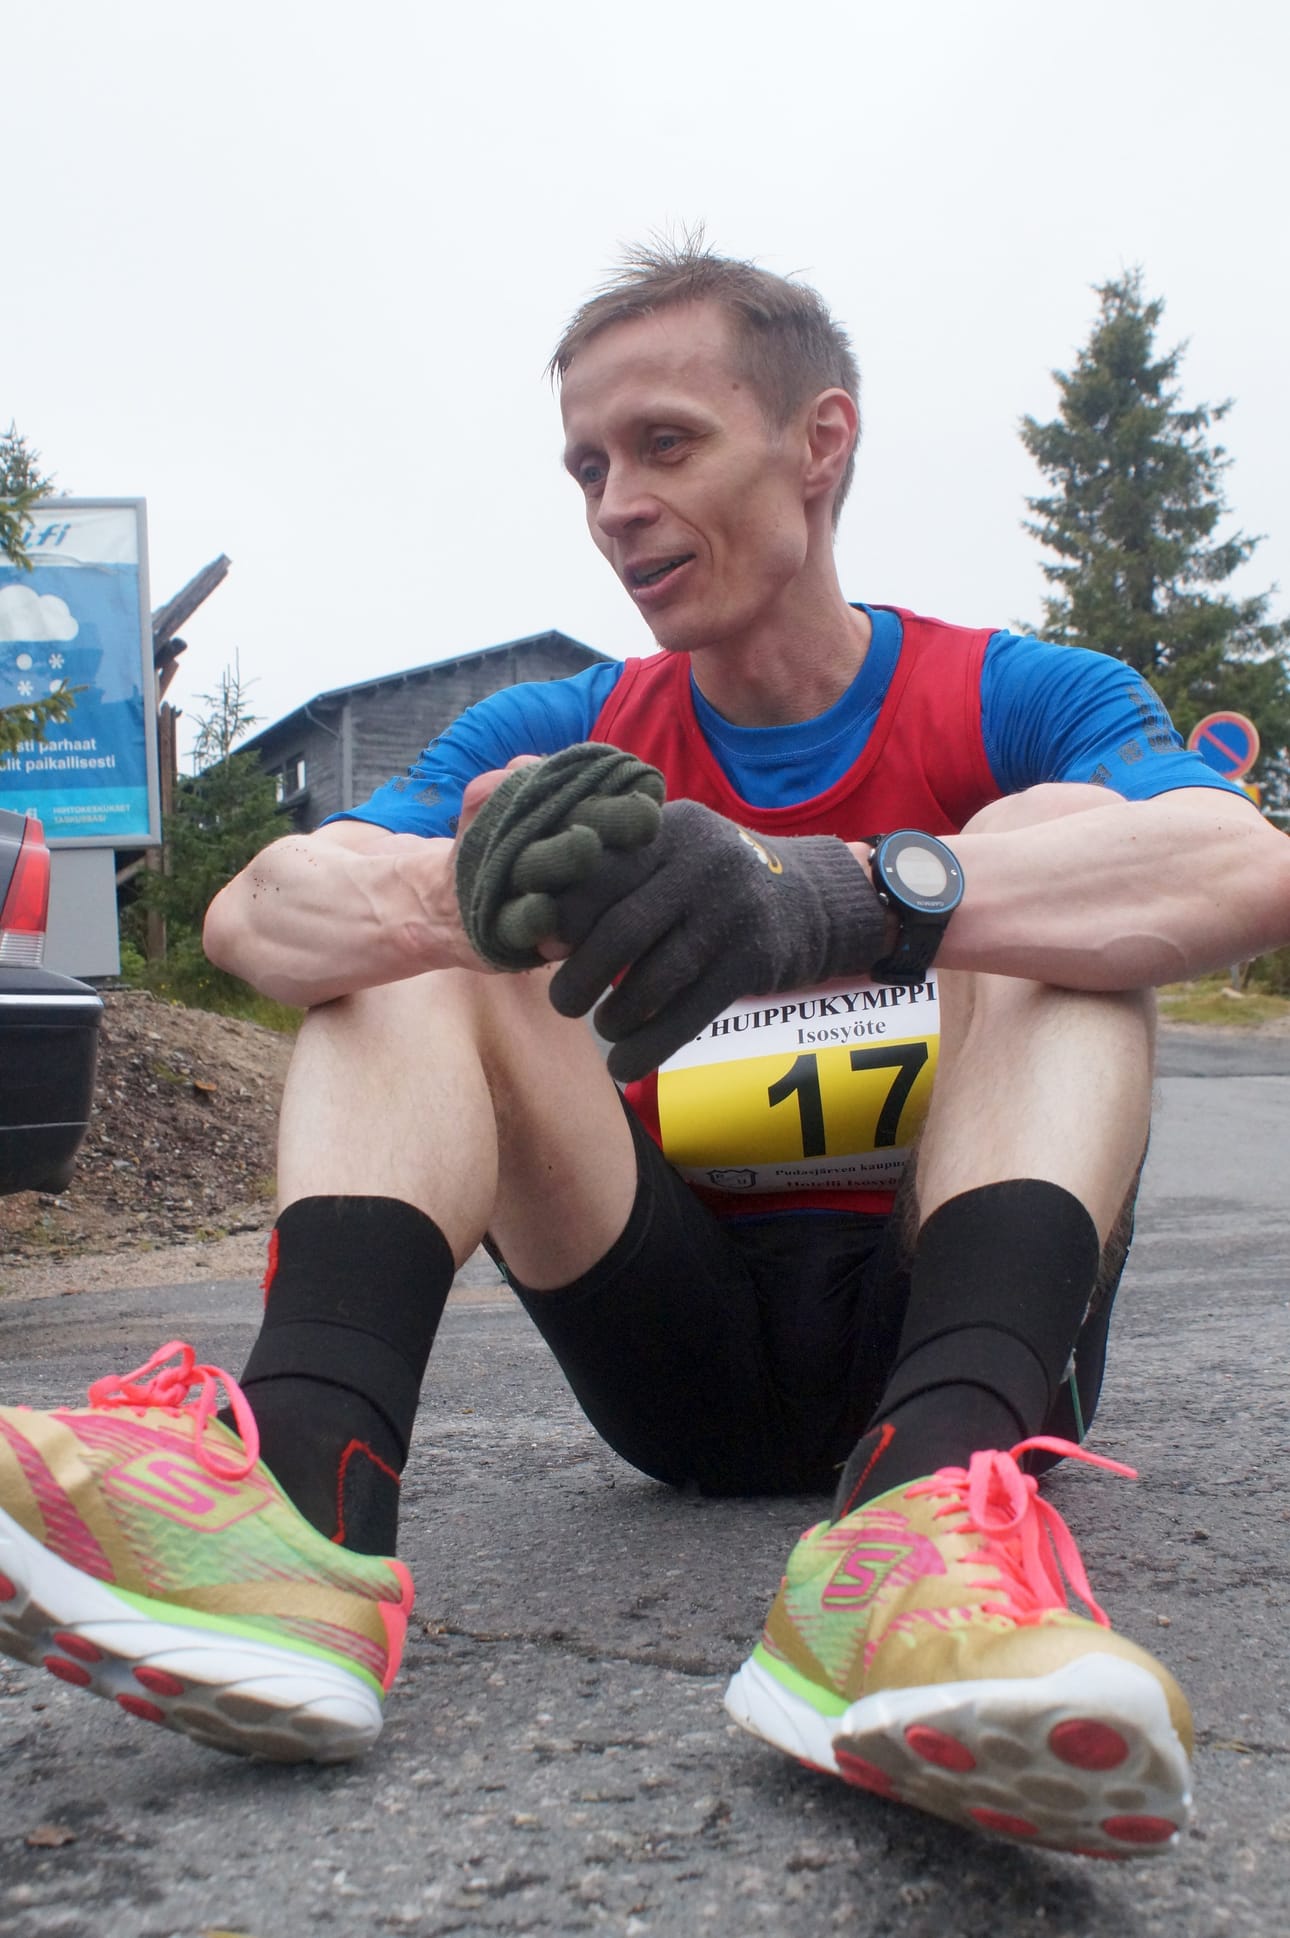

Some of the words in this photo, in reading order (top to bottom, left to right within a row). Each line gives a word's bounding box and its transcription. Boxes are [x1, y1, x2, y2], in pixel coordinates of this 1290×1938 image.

[39, 738, 97, 754] parhaat
[25, 755, 116, 774] paikallisesti
[709, 981, 938, 1038] HUIPPUKYMPPI
[796, 1019, 887, 1044] Isosyöte
[767, 1042, 929, 1158] 17
